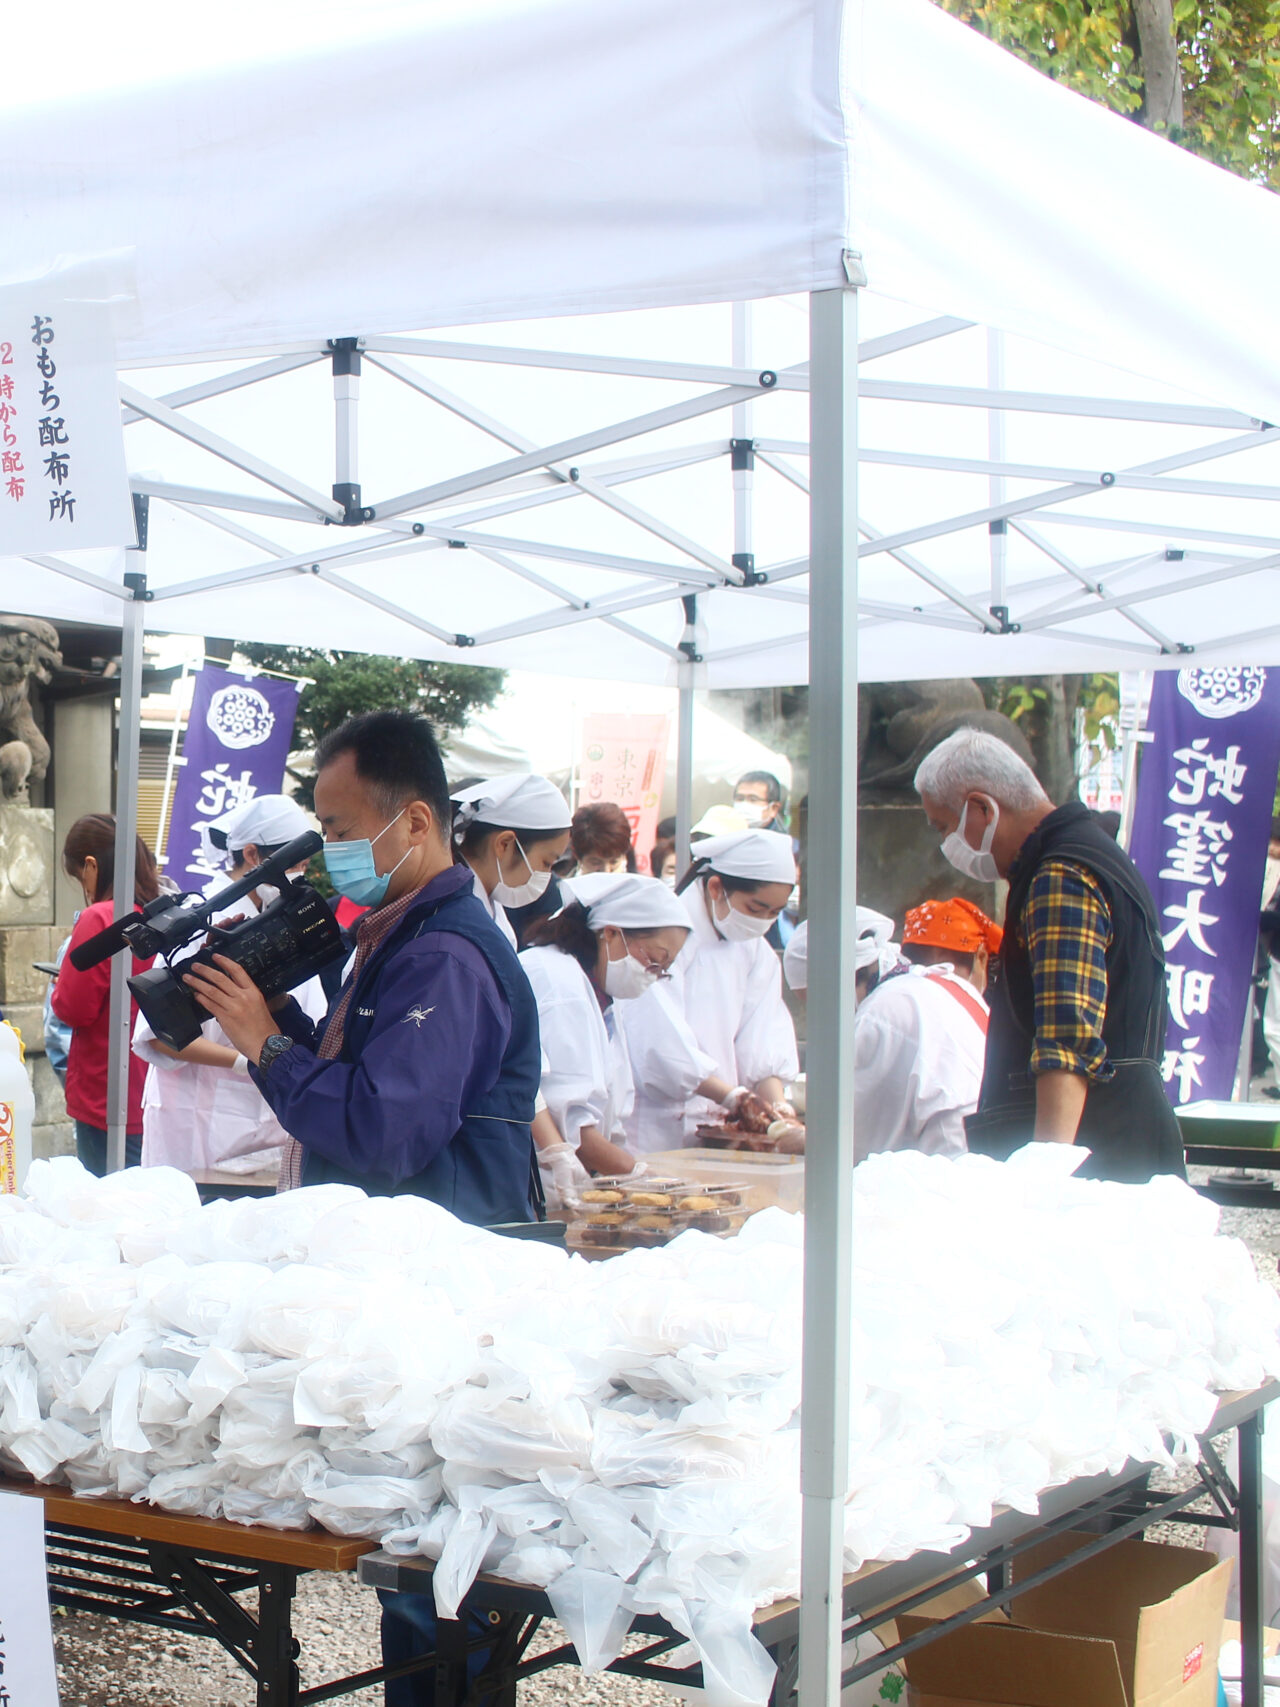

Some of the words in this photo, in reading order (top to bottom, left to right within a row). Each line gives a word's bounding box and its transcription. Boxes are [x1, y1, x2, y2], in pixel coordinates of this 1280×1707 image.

[31, 315, 76, 523] おもち配布所
[614, 747, 637, 798] 東京
[298, 901, 316, 915] SONY
